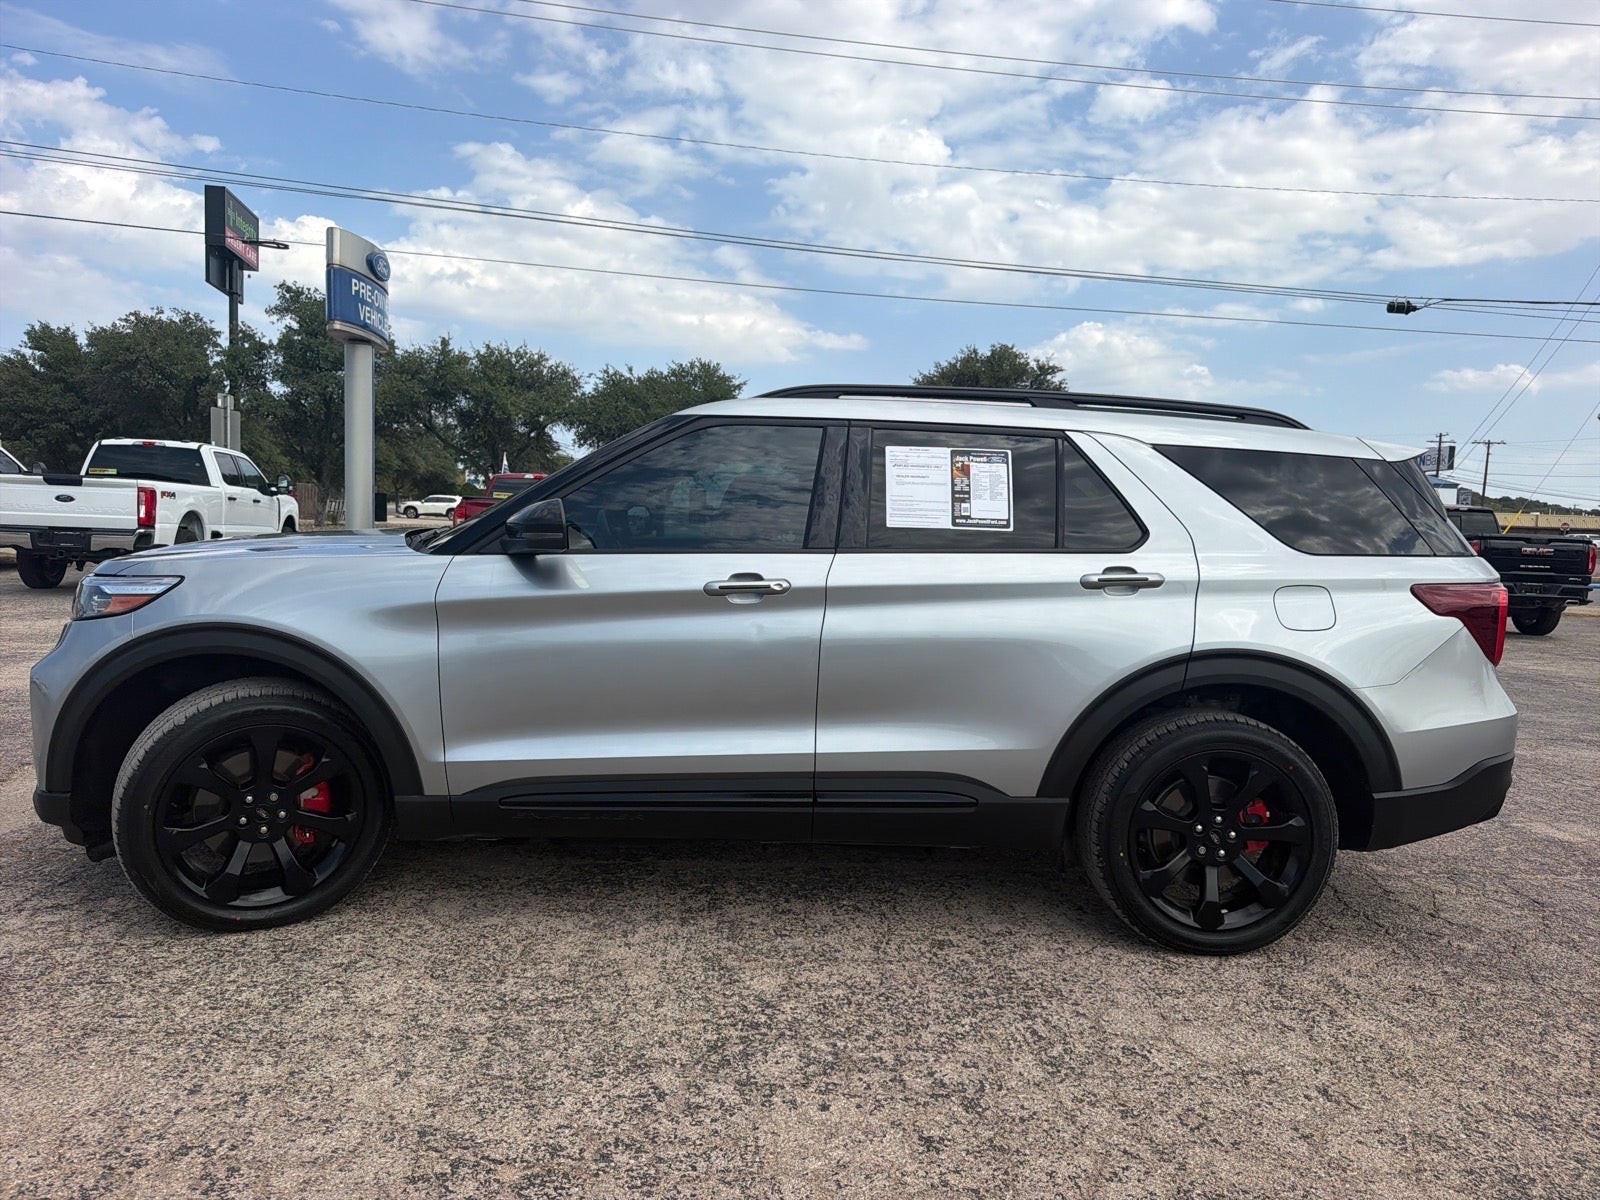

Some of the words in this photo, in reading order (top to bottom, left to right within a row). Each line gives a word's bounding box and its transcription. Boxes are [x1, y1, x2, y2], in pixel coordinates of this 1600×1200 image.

[245, 246, 258, 264] CARE
[1419, 454, 1447, 466] NBak
[1521, 547, 1555, 556] GMC
